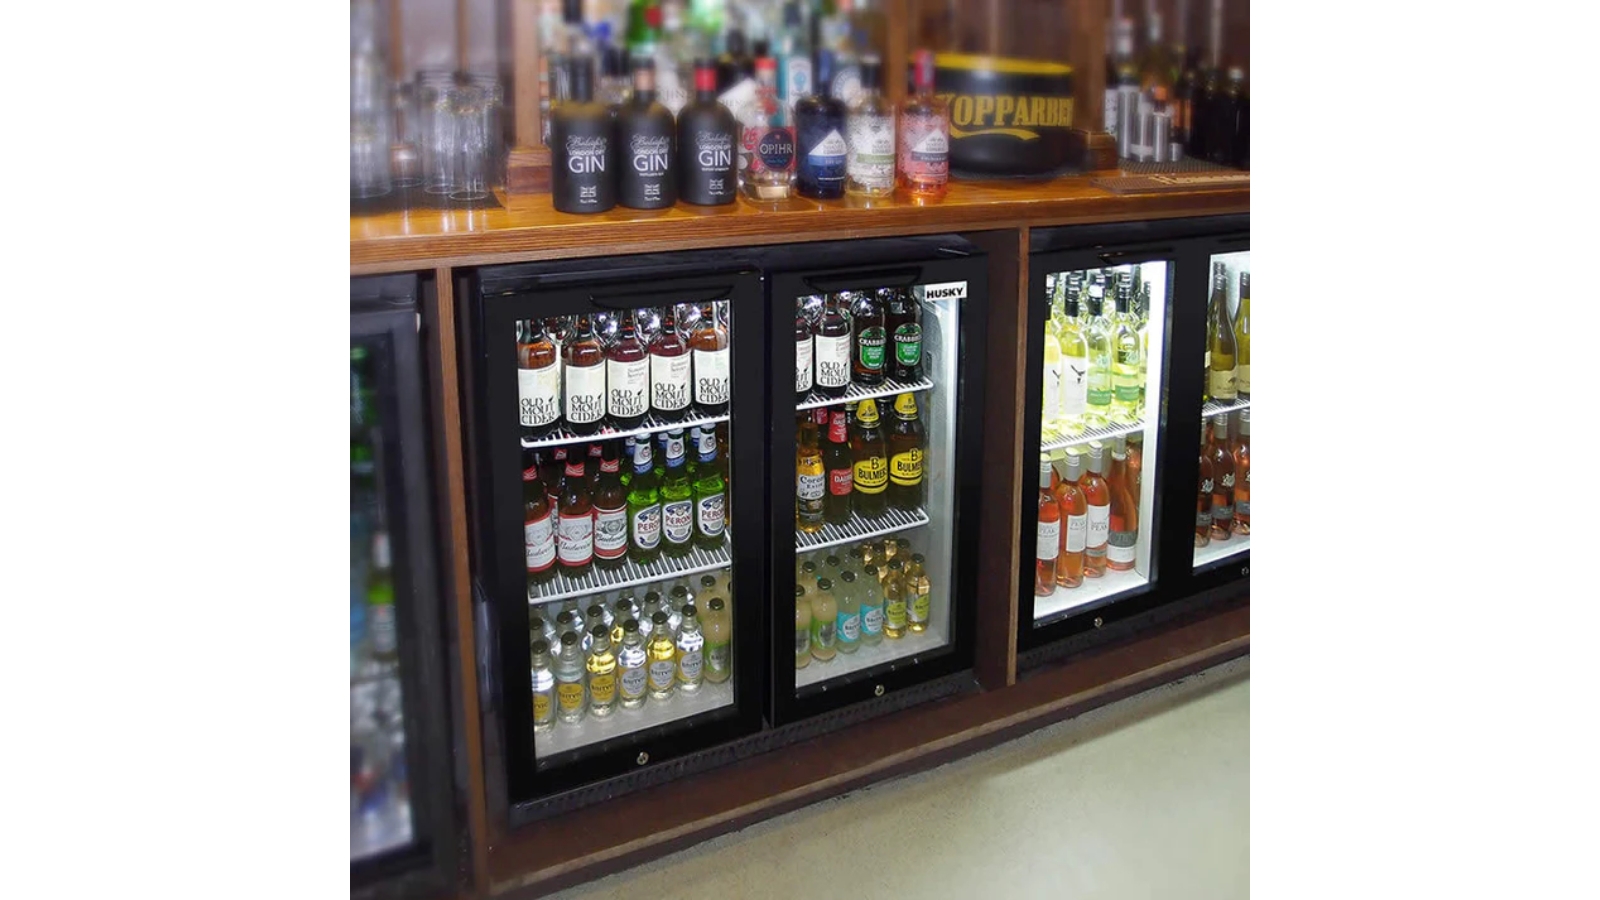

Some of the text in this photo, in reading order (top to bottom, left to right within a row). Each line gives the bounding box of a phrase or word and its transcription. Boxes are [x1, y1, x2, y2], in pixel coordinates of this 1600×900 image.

[759, 143, 792, 154] OPIHR
[568, 155, 605, 173] GIN
[633, 154, 668, 171] GIN
[698, 150, 731, 167] GIN
[926, 287, 963, 299] HUSKY
[821, 361, 841, 369] OLD
[654, 382, 676, 392] OLD
[699, 377, 721, 387] OLD
[611, 388, 633, 398] OLD
[521, 397, 544, 407] OLD
[570, 394, 593, 404] OLD
[654, 397, 686, 408] CIDER
[570, 409, 603, 421] CIDER
[610, 404, 643, 415] CIDER
[521, 411, 555, 424] CIDER
